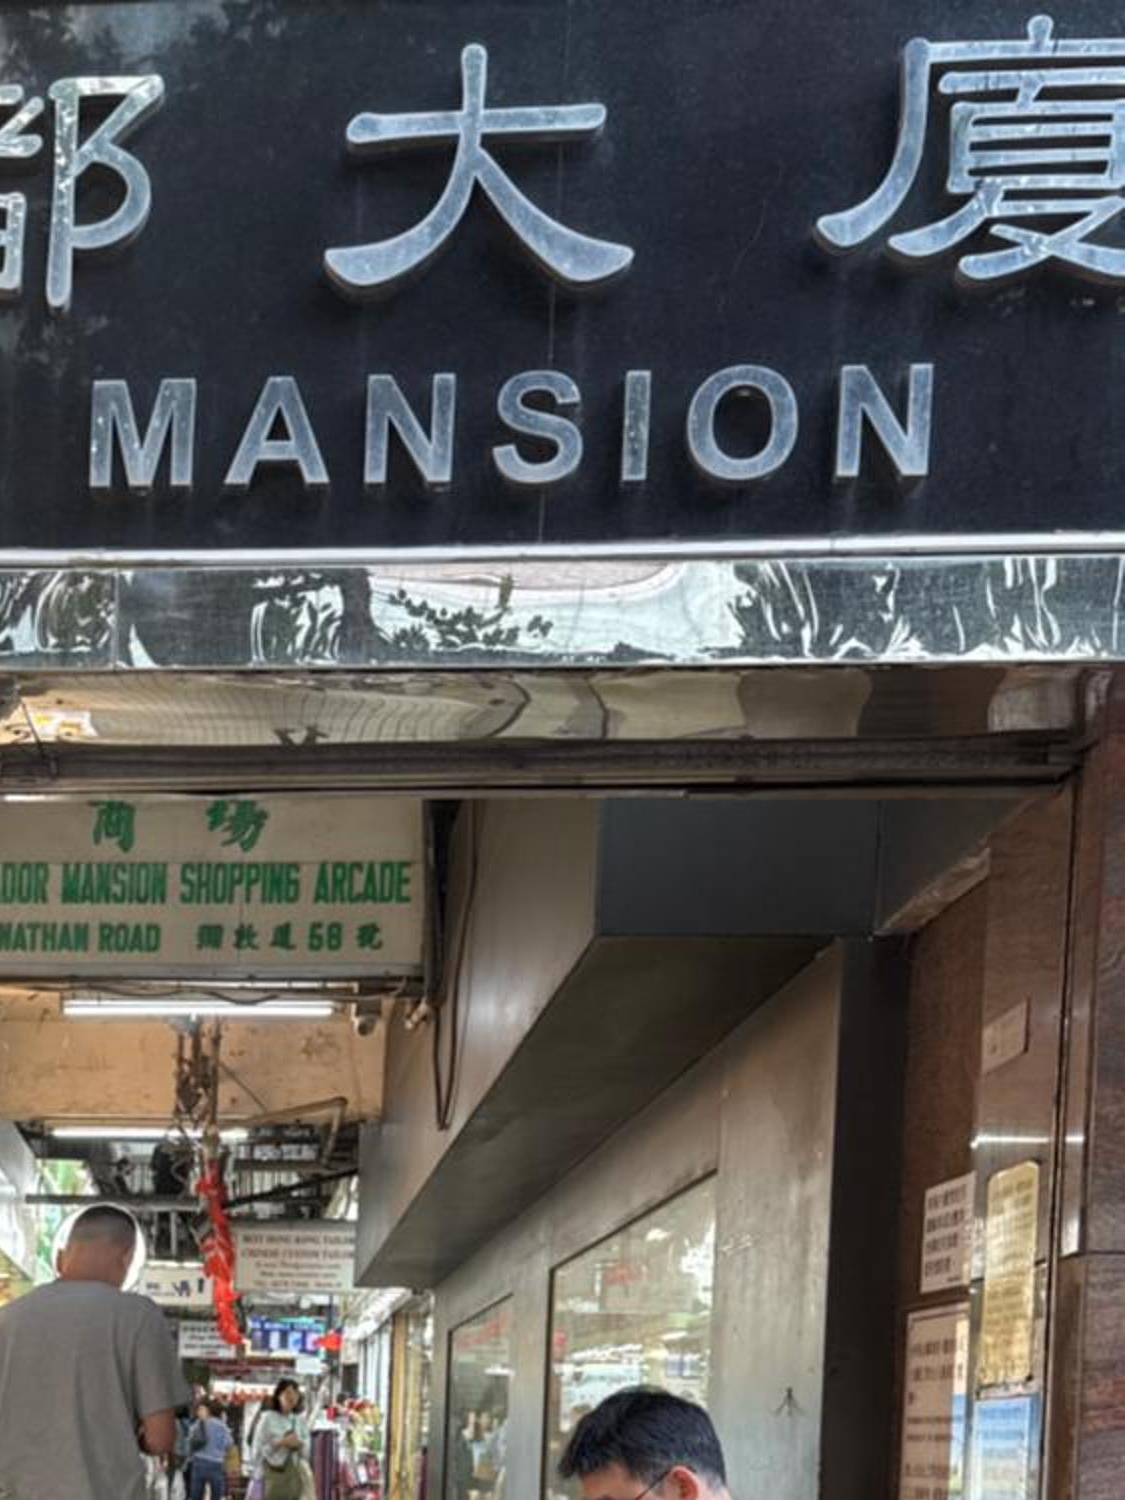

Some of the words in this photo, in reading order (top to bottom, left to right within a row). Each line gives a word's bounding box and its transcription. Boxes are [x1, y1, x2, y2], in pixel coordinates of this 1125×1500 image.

[88, 362, 934, 488] MANSION
[60, 862, 167, 904] MANSION
[179, 862, 299, 904] SHOPPING
[314, 861, 412, 904] ARCADE
[97, 923, 160, 953] ROAD
